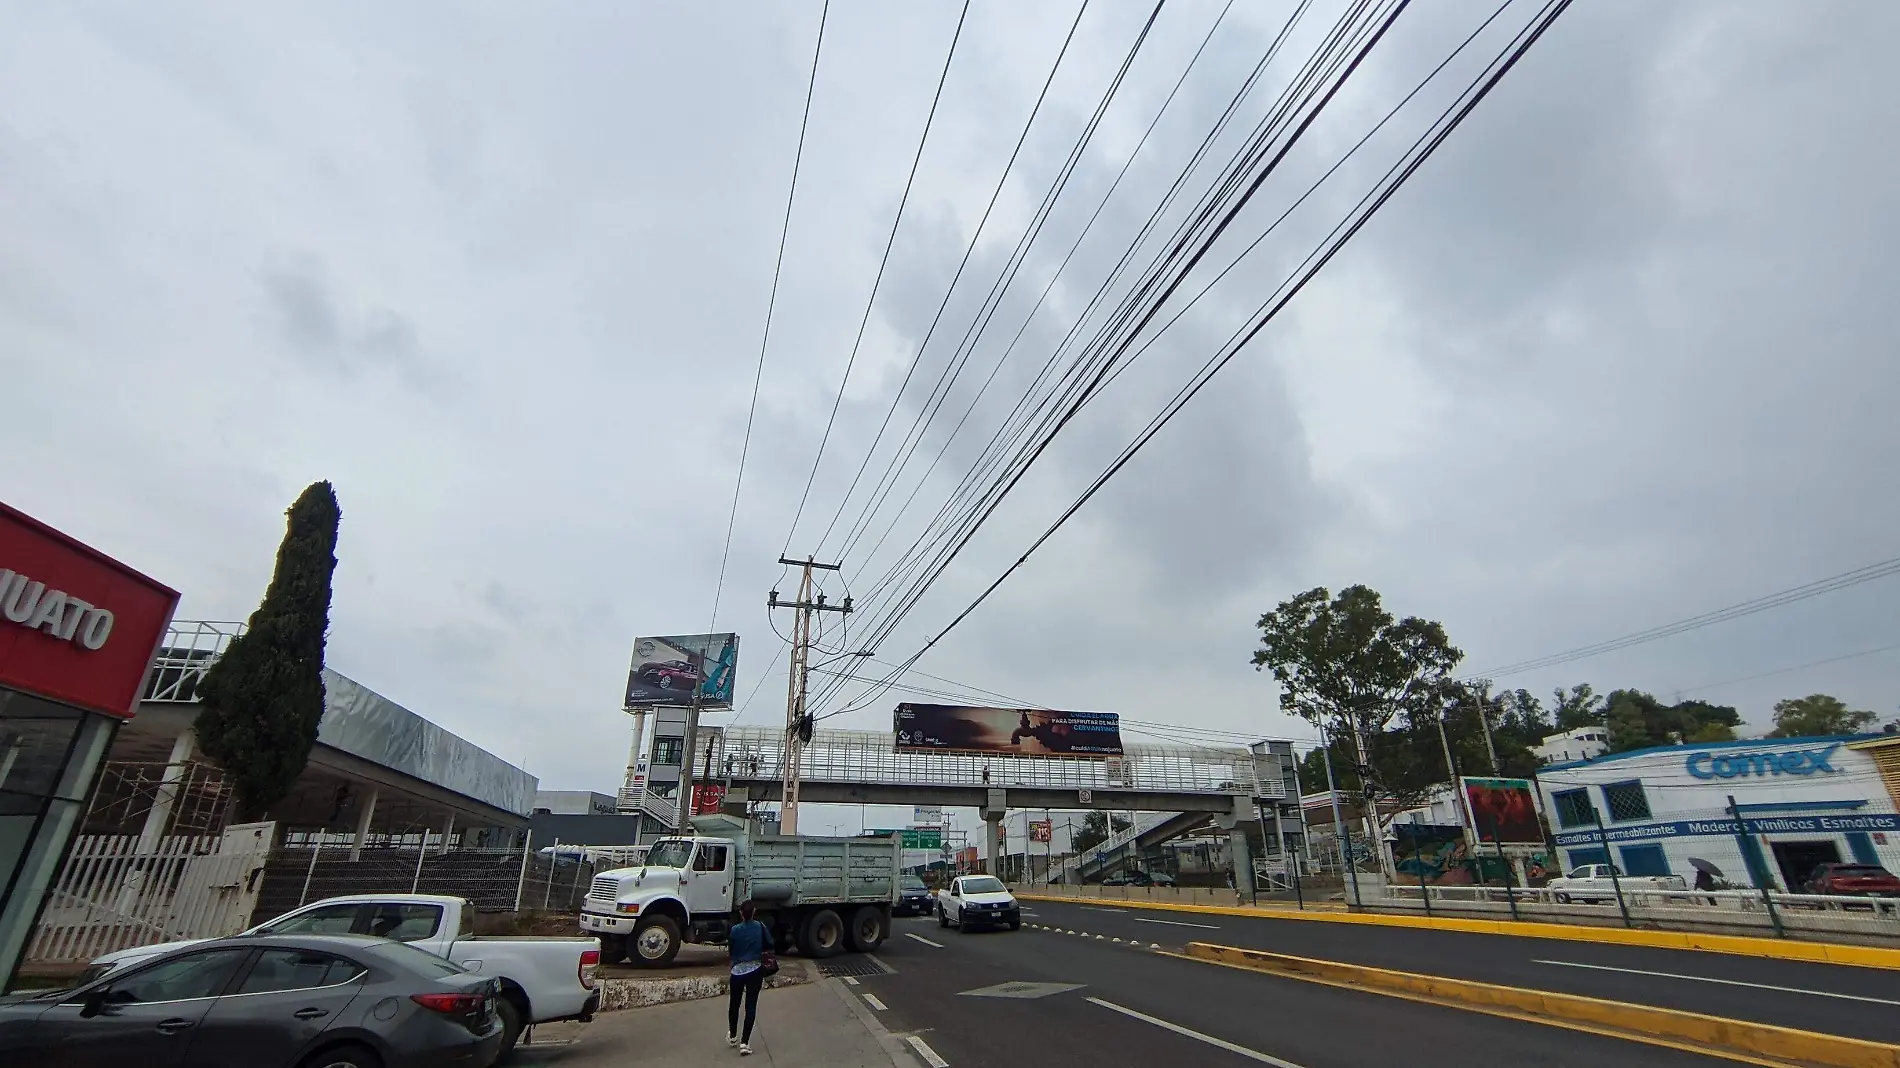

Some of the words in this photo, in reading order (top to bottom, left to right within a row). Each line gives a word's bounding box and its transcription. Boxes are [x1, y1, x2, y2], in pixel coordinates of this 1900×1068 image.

[1687, 742, 1841, 780] Comex
[1821, 813, 1896, 829] Esmaltes
[1555, 833, 1592, 844] Esmaltes
